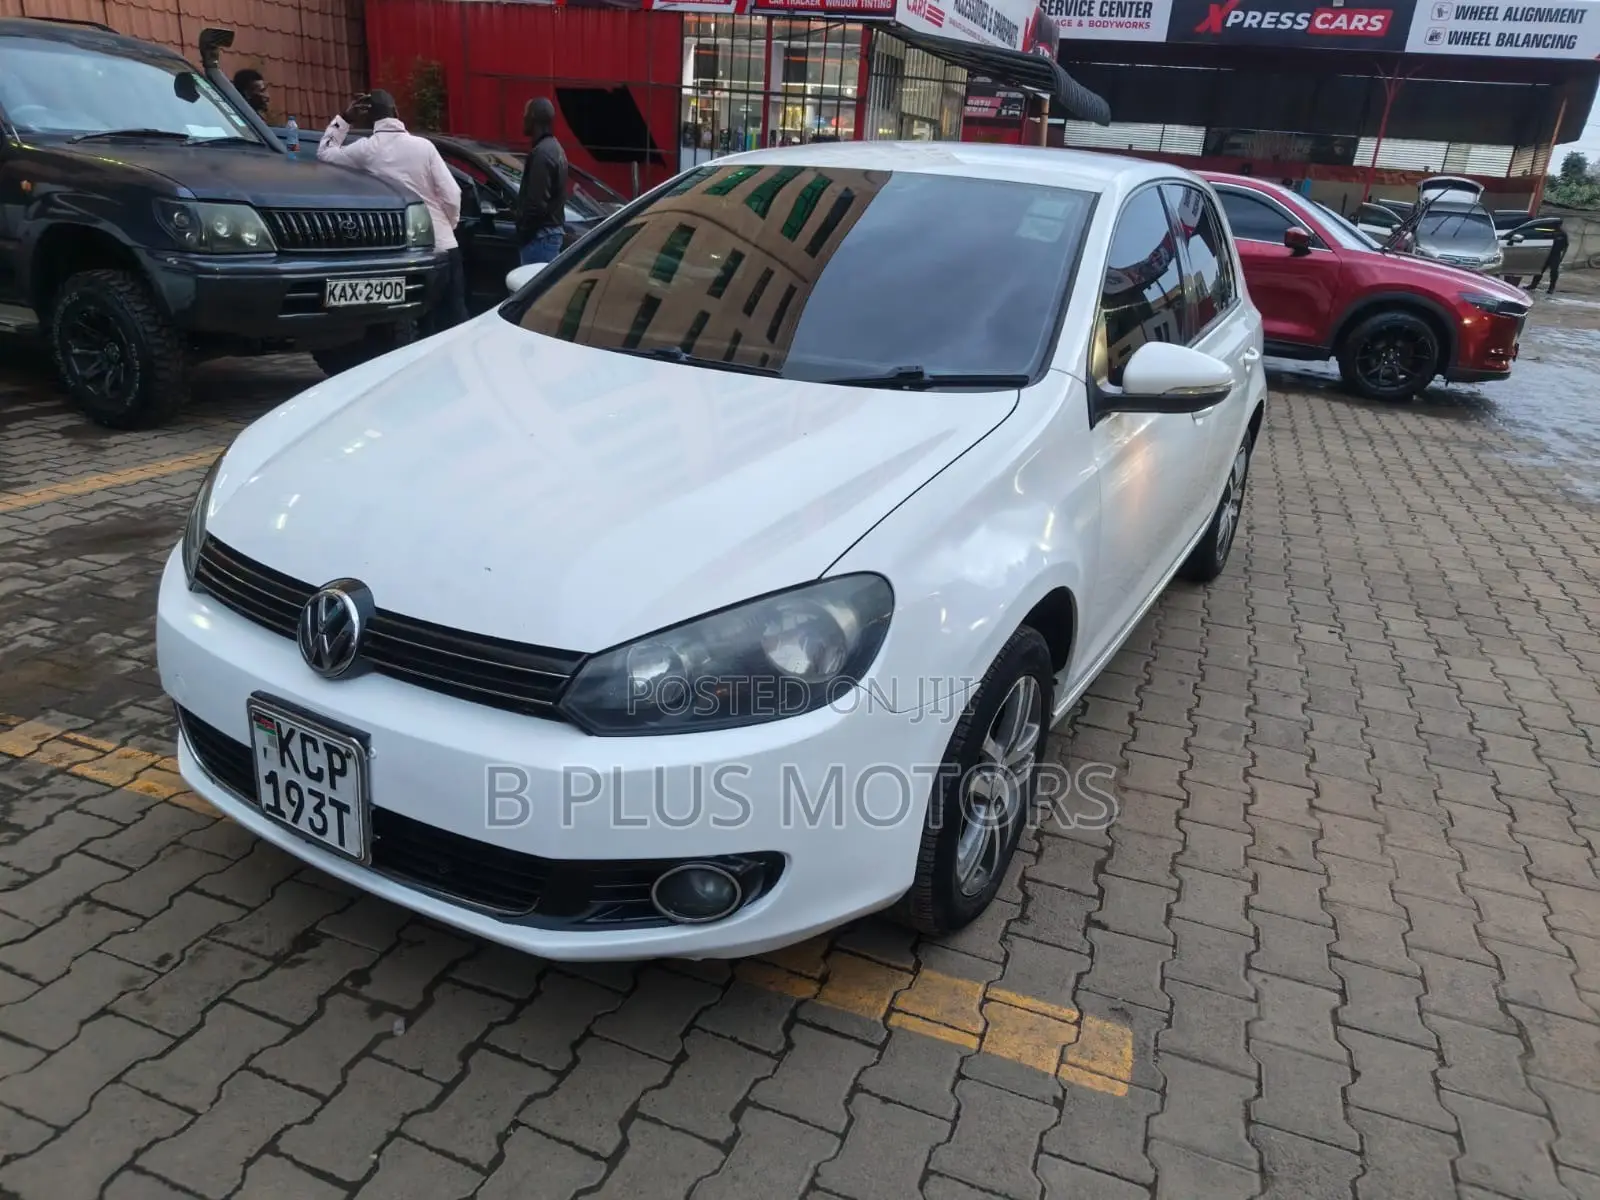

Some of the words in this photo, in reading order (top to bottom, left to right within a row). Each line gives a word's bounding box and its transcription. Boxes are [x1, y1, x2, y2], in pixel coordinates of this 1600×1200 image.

[825, 0, 858, 8] WINDOW
[861, 0, 892, 9] TINTING
[1040, 0, 1095, 17] SERVICE
[1099, 0, 1153, 19] CENTER
[1454, 5, 1499, 21] WHEEL
[1502, 6, 1588, 24] ALIGNMENT
[1088, 20, 1151, 30] BODYWORKS
[1193, 0, 1312, 34] XPRESS
[1314, 13, 1385, 32] CARS
[1447, 30, 1492, 47] WHEEL
[1495, 32, 1578, 50] BALANCING
[328, 283, 360, 303] KAX
[276, 721, 348, 791] KCP
[264, 769, 351, 847] 193T
